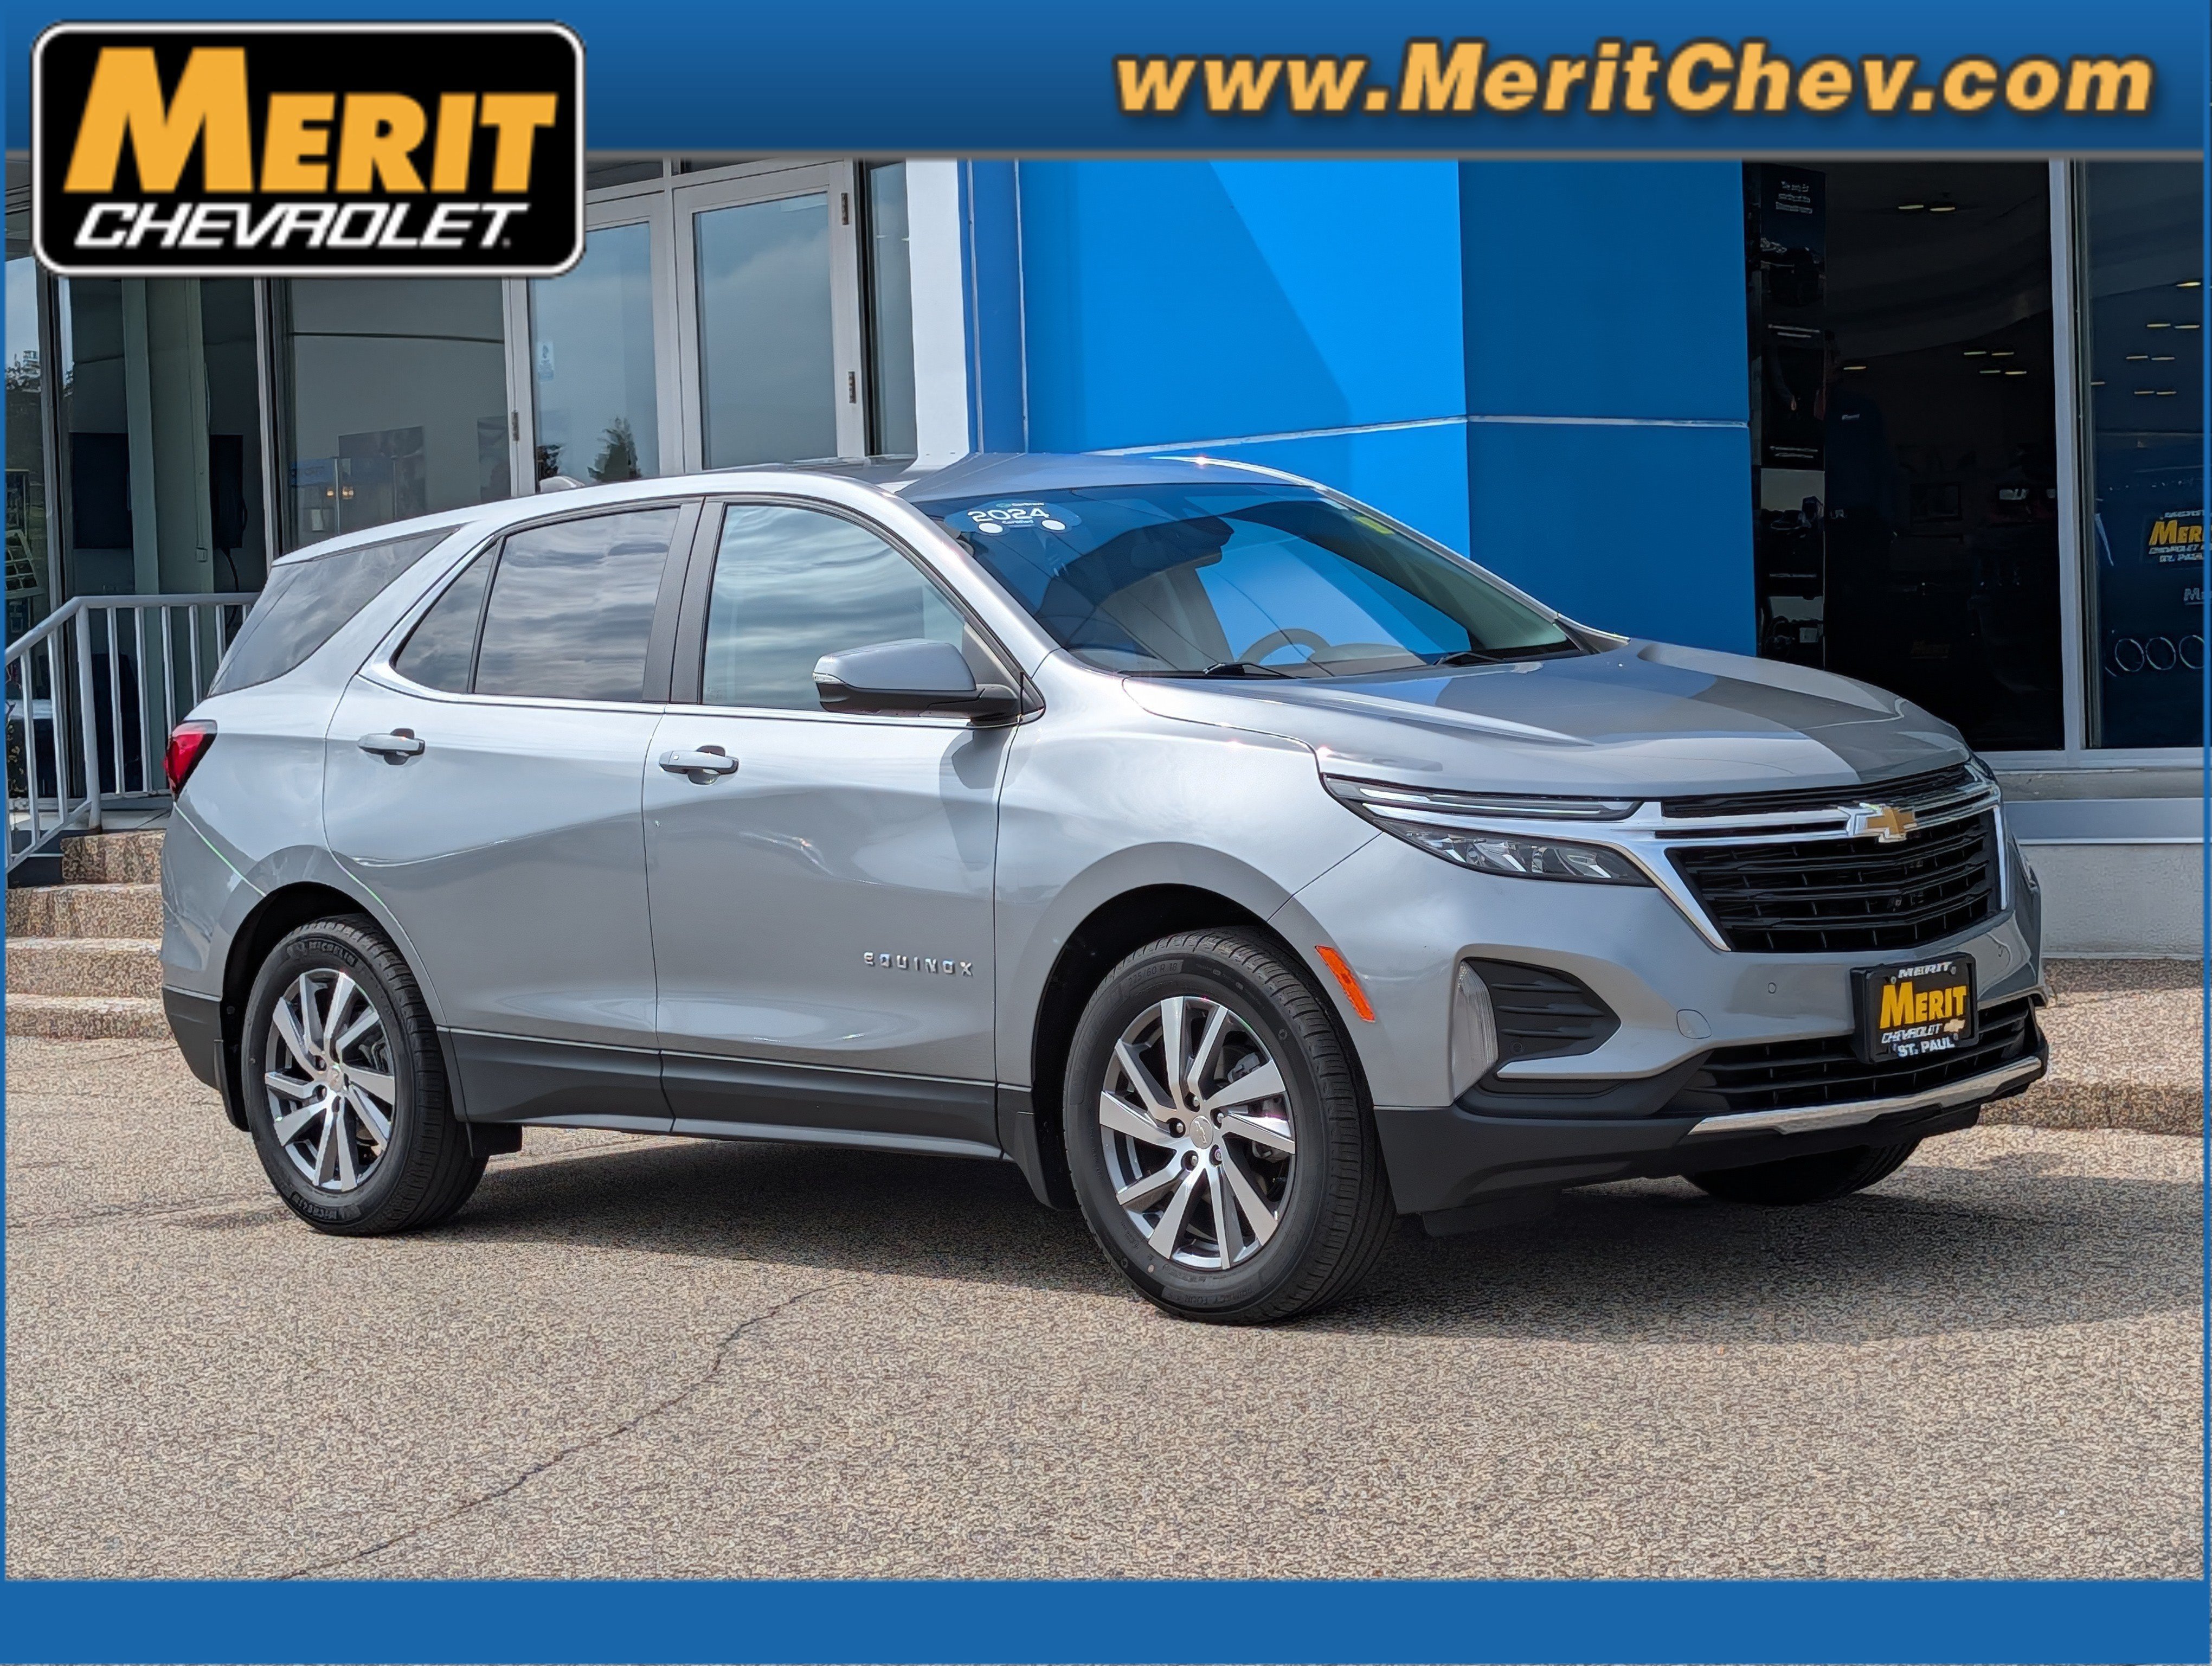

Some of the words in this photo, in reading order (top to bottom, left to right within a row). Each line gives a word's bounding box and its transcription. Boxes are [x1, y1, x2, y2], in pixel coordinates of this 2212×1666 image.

[968, 508, 1050, 522] 2024
[864, 952, 973, 976] EQUINOX
[1898, 962, 1953, 978] MERIT
[1881, 1023, 1943, 1043] CHEVROLET
[1898, 1043, 1919, 1058] ST.
[1921, 1036, 1955, 1053] PAUL
